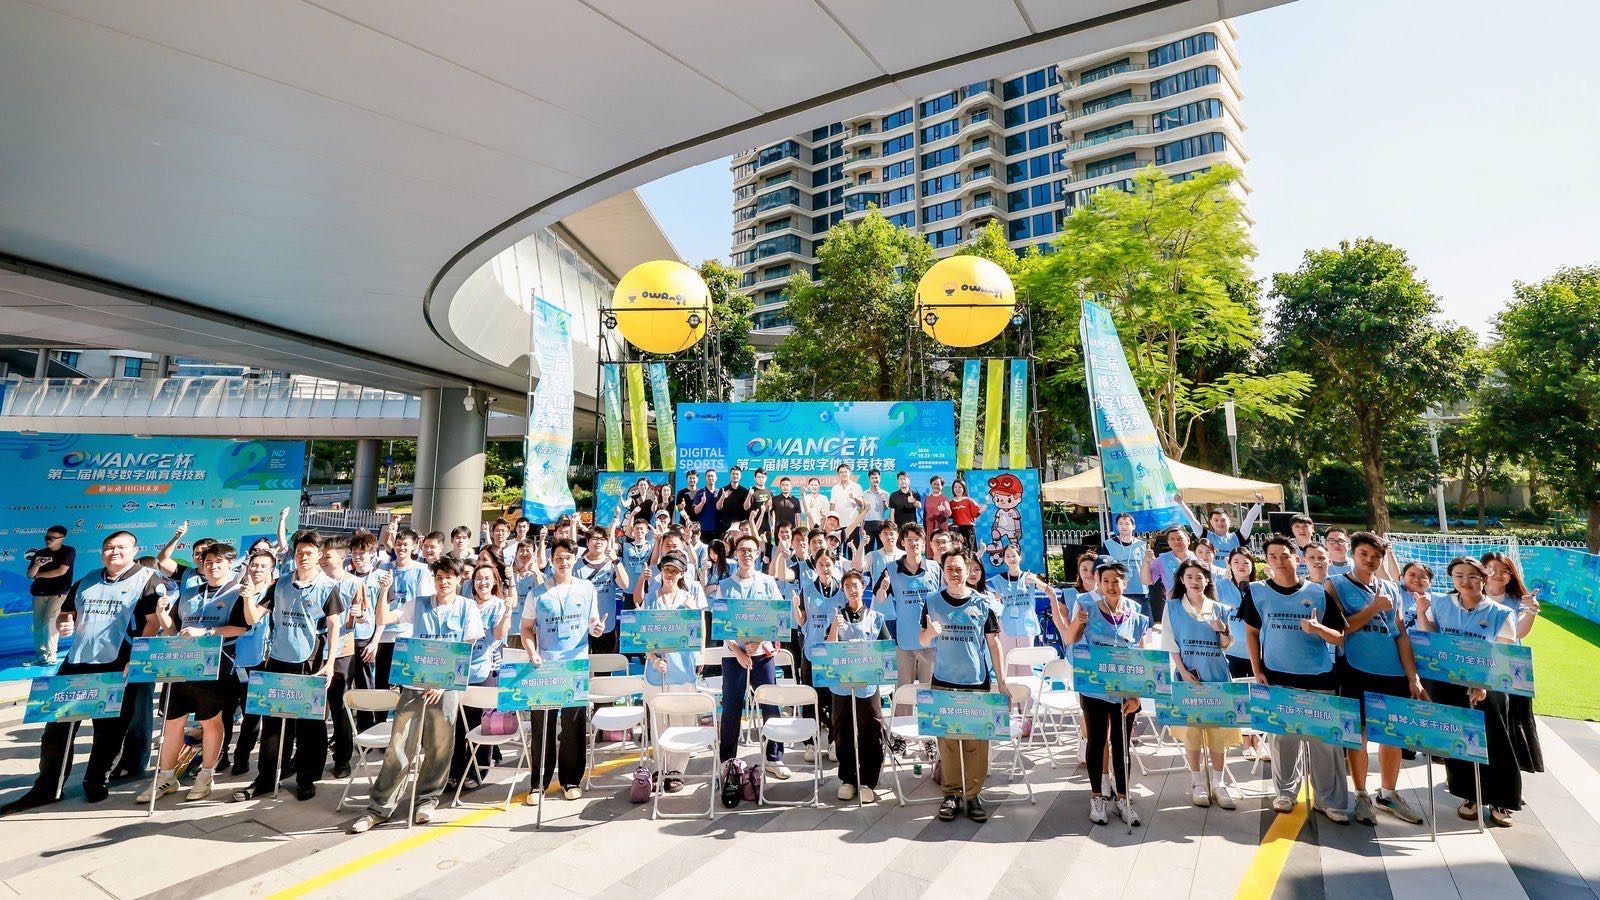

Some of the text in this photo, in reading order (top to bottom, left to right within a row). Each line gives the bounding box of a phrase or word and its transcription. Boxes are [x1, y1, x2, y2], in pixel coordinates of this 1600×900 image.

[1015, 378, 1024, 455] DIGITAL SPORTS
[272, 449, 286, 457] ND
[680, 448, 725, 458] DIGITAL
[680, 459, 725, 470] SPORTS
[736, 457, 896, 472] 第二届横琴数字体育竞技赛
[46, 468, 207, 482] 第二届横琴数字体育竞技赛
[1388, 713, 1463, 734] 横琴人家干饭队
